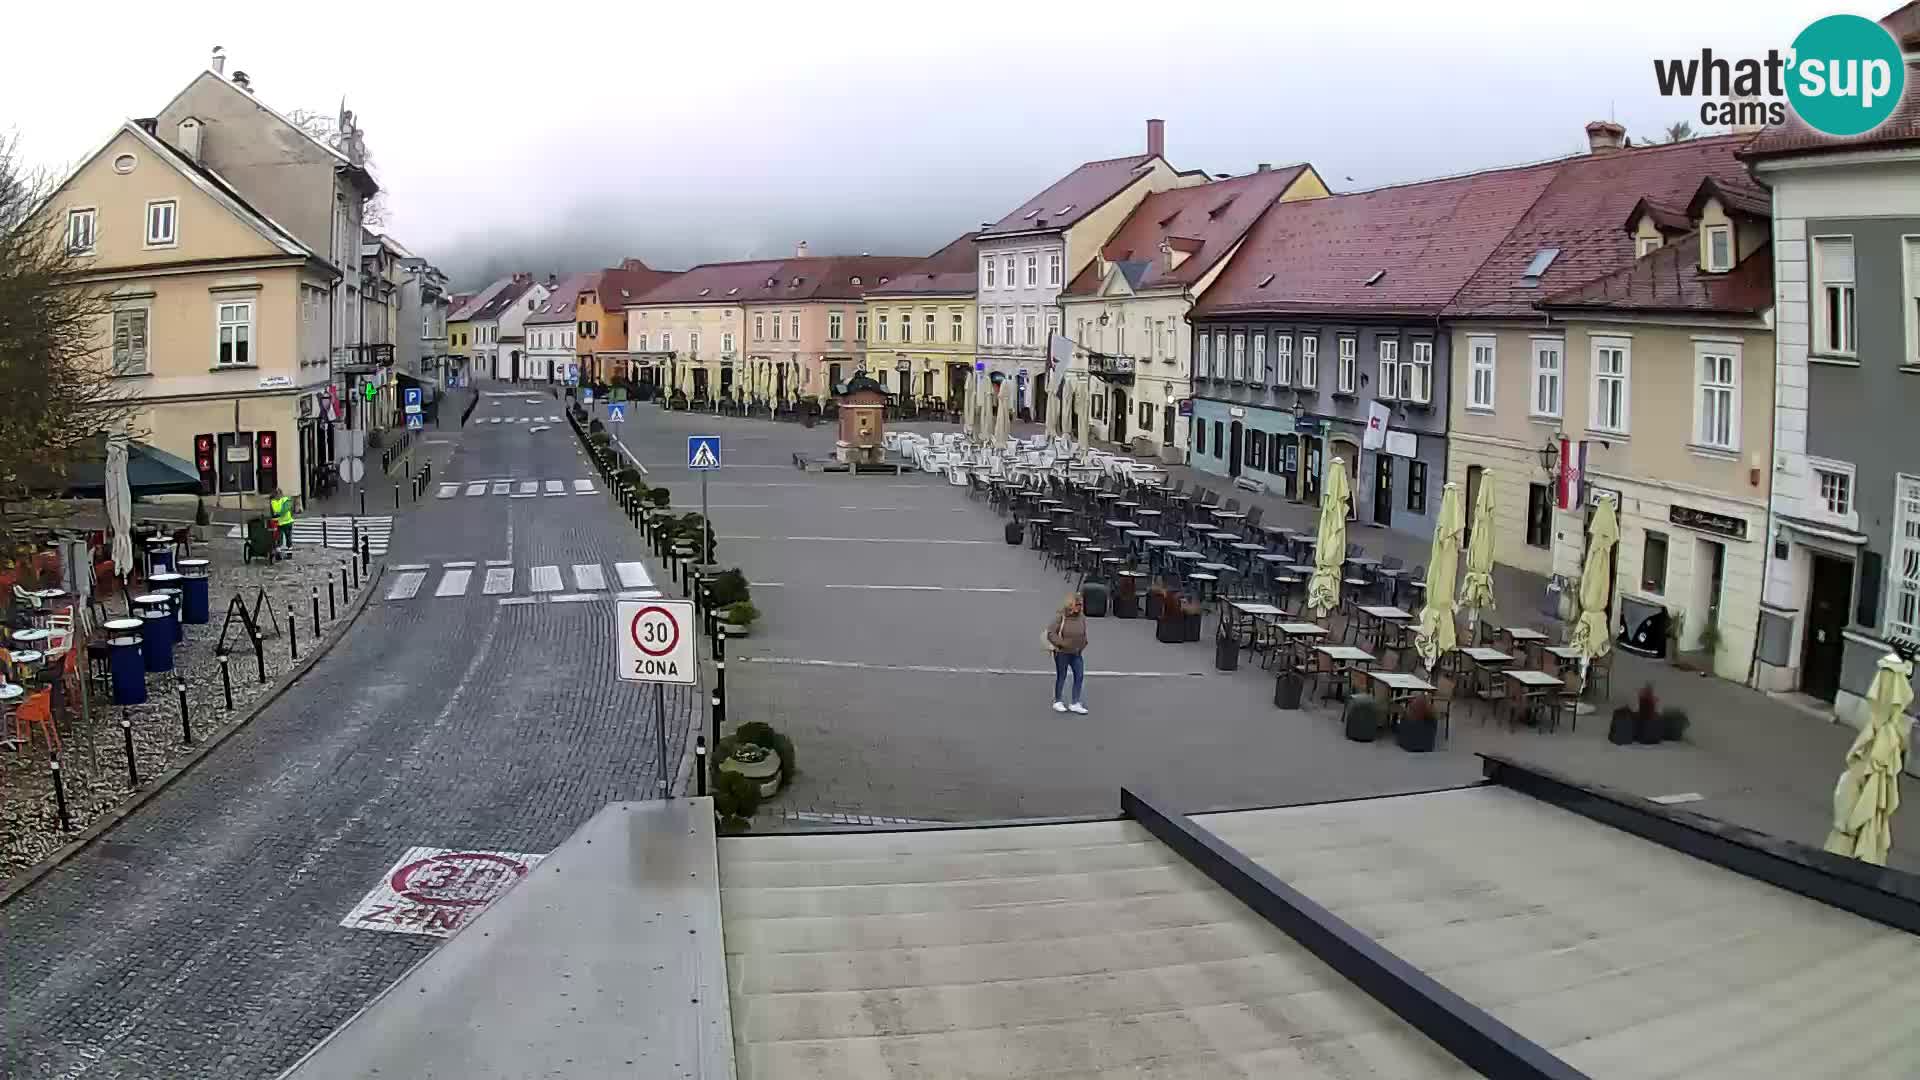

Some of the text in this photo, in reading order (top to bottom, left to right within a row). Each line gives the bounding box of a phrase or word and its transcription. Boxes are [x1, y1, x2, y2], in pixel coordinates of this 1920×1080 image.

[409, 392, 417, 402] P
[644, 622, 668, 643] 30
[634, 660, 678, 676] ZONA
